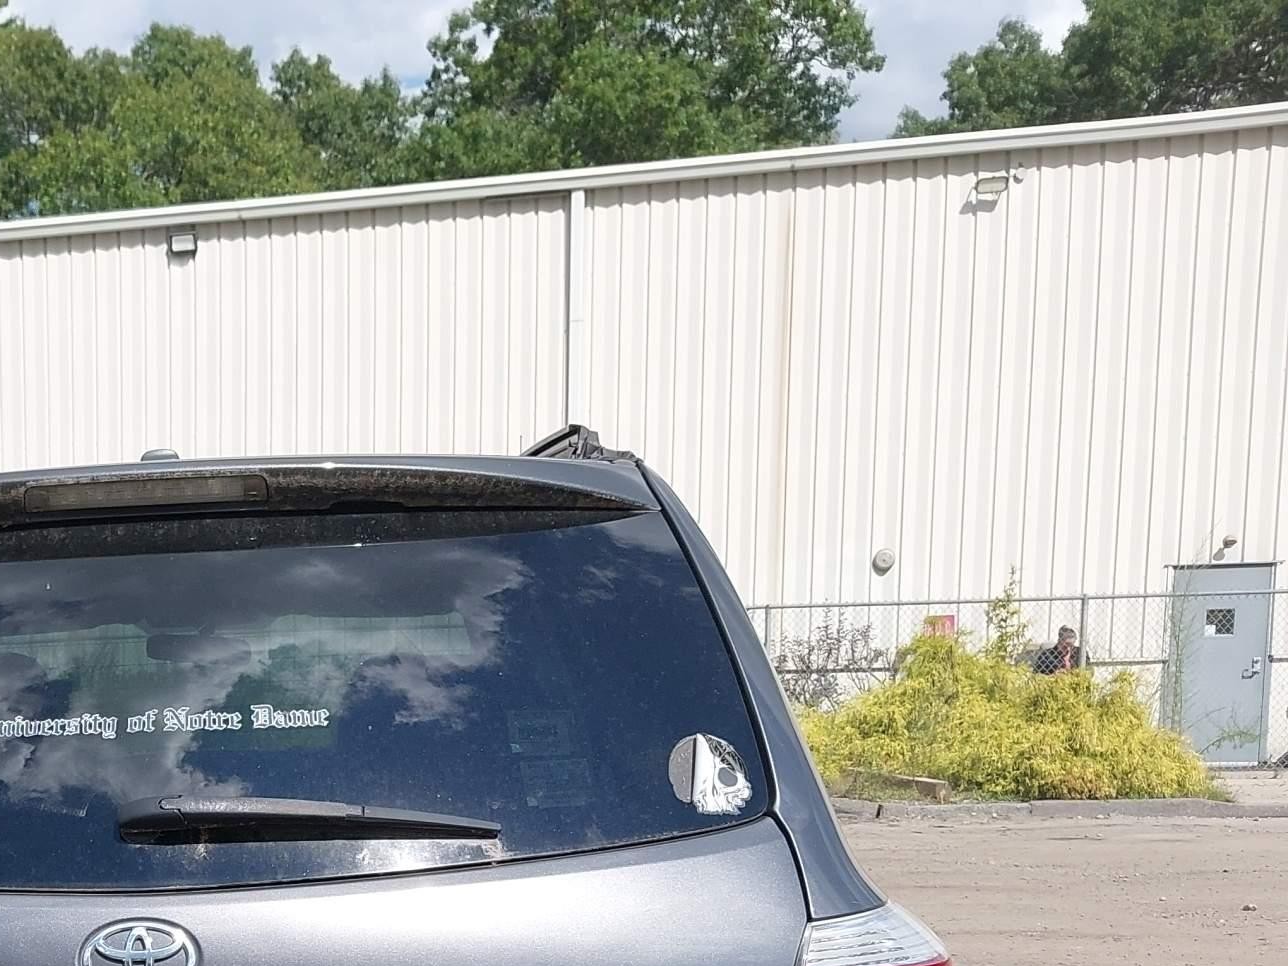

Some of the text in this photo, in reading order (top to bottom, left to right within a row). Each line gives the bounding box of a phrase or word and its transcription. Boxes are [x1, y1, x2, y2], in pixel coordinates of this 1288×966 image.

[126, 709, 159, 733] of
[163, 707, 242, 732] Notre
[250, 704, 330, 729] Dame
